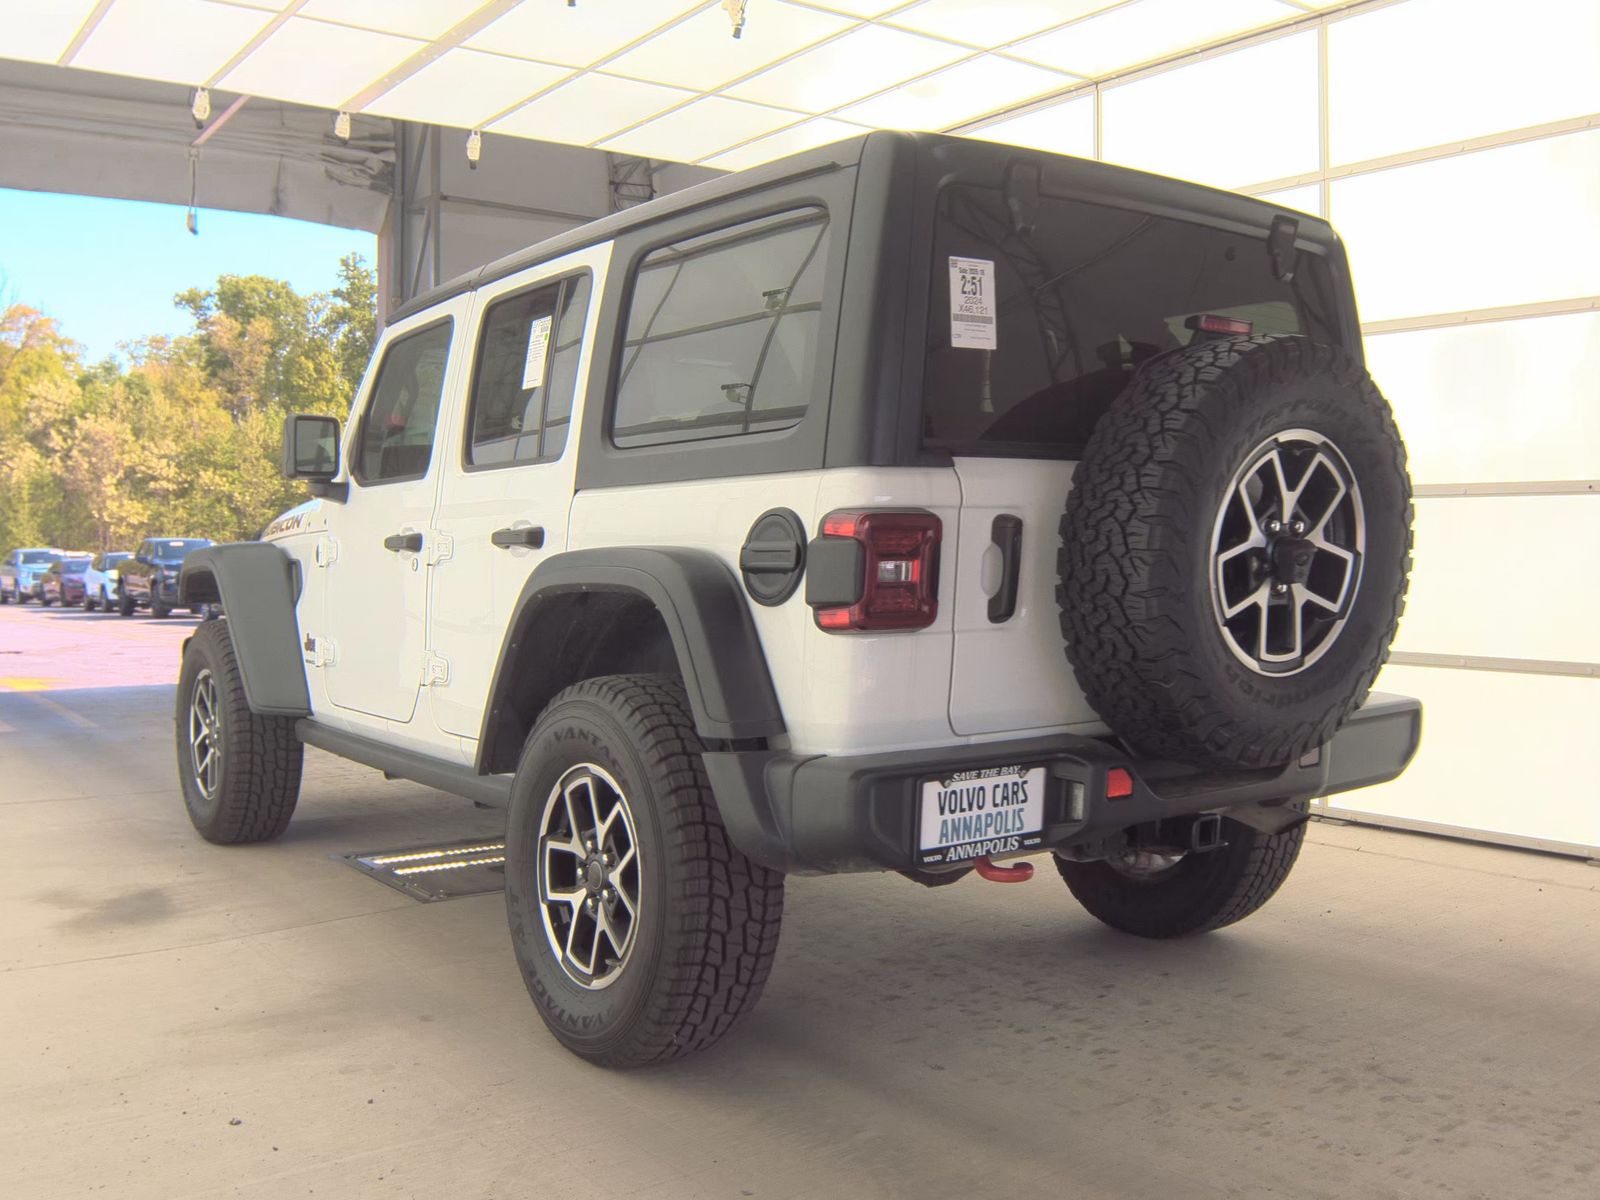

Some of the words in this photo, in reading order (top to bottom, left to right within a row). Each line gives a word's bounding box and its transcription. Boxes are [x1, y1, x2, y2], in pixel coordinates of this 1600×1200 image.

[960, 275, 982, 296] 2:51
[951, 770, 979, 782] SAVE
[980, 767, 1000, 779] THE
[1000, 765, 1021, 776] BAY
[937, 785, 986, 816] VOLVO
[992, 780, 1028, 808] CARS
[938, 807, 1025, 844] ANNAPOLIS
[946, 836, 1020, 861] ANNAPOLIS
